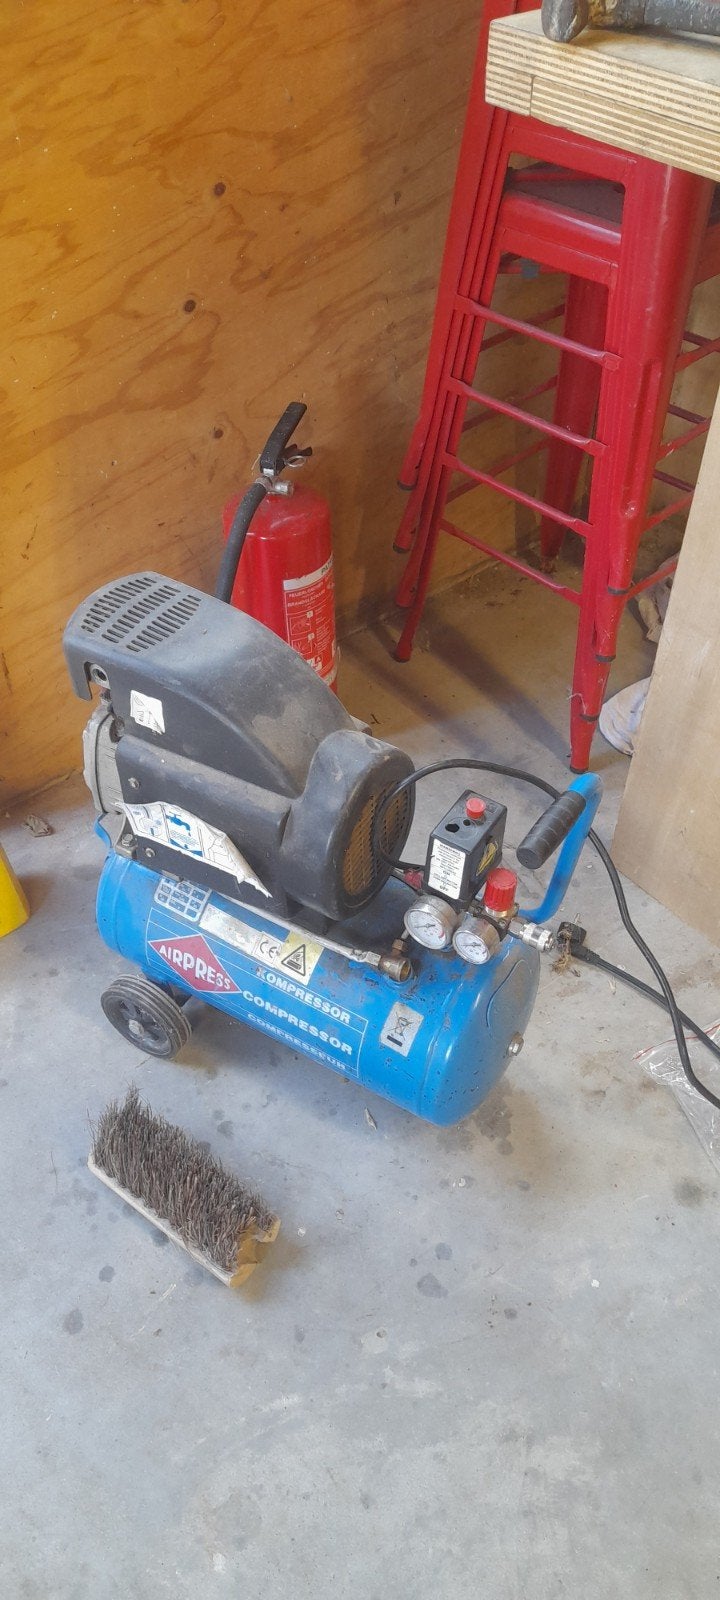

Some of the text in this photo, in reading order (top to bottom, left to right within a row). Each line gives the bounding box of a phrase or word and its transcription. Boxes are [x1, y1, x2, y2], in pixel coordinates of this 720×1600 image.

[159, 944, 232, 990] AIRPRESS
[255, 966, 351, 1024] KOMPRESSOR
[242, 990, 353, 1055] COMPRESSOR
